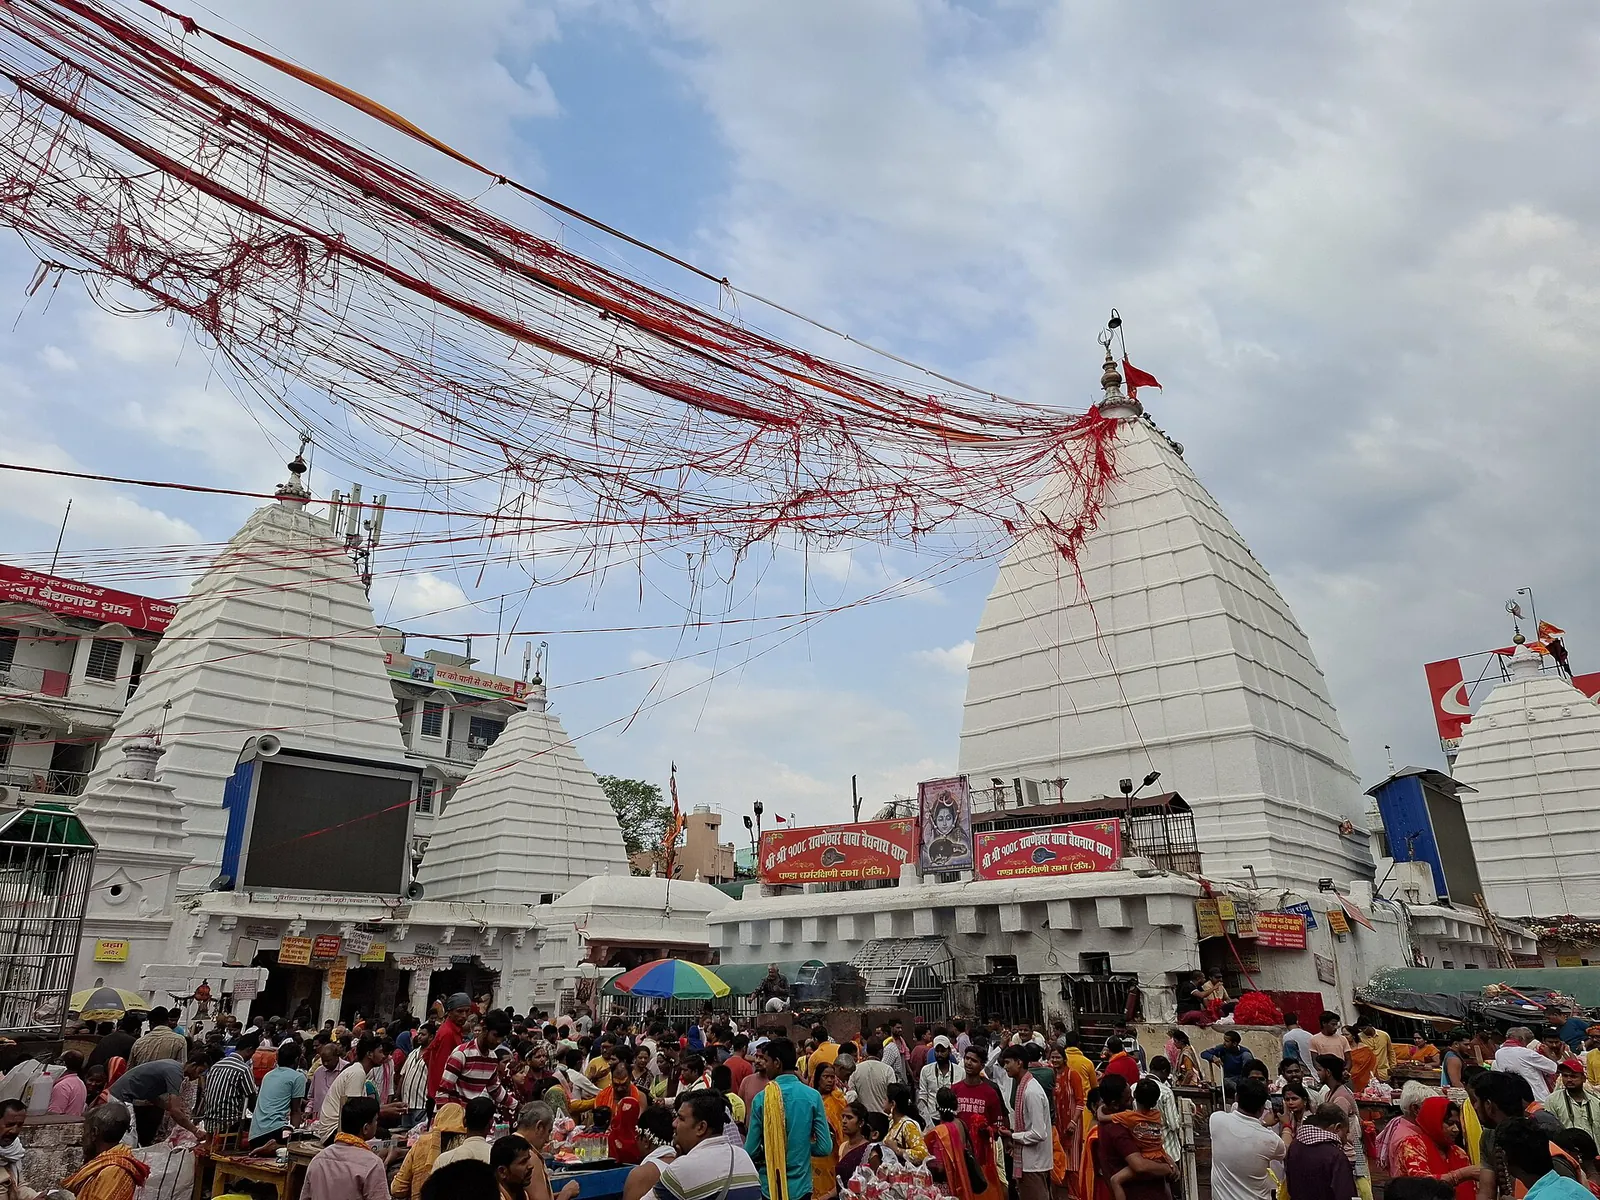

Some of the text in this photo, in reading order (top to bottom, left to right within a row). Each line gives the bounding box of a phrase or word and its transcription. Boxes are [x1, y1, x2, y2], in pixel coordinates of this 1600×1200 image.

[436, 670, 446, 679] घर
[447, 671, 458, 681] को
[458, 675, 473, 684] पानी
[474, 677, 481, 686] से
[493, 682, 511, 693] शील्ड
[765, 852, 776, 871] श्री
[776, 845, 787, 864] श्री
[788, 839, 807, 858] १००८
[808, 830, 842, 850] रावणेश्वर
[843, 831, 861, 847] बाबा
[982, 852, 991, 870] श्री
[991, 846, 1001, 863] श्री
[1001, 840, 1018, 856] १००८
[1019, 831, 1050, 849] रावणेश्वर
[1051, 832, 1068, 845] बाबा
[778, 872, 798, 880] पण्डा
[840, 868, 859, 877] सभा
[1051, 864, 1068, 872] सभा
